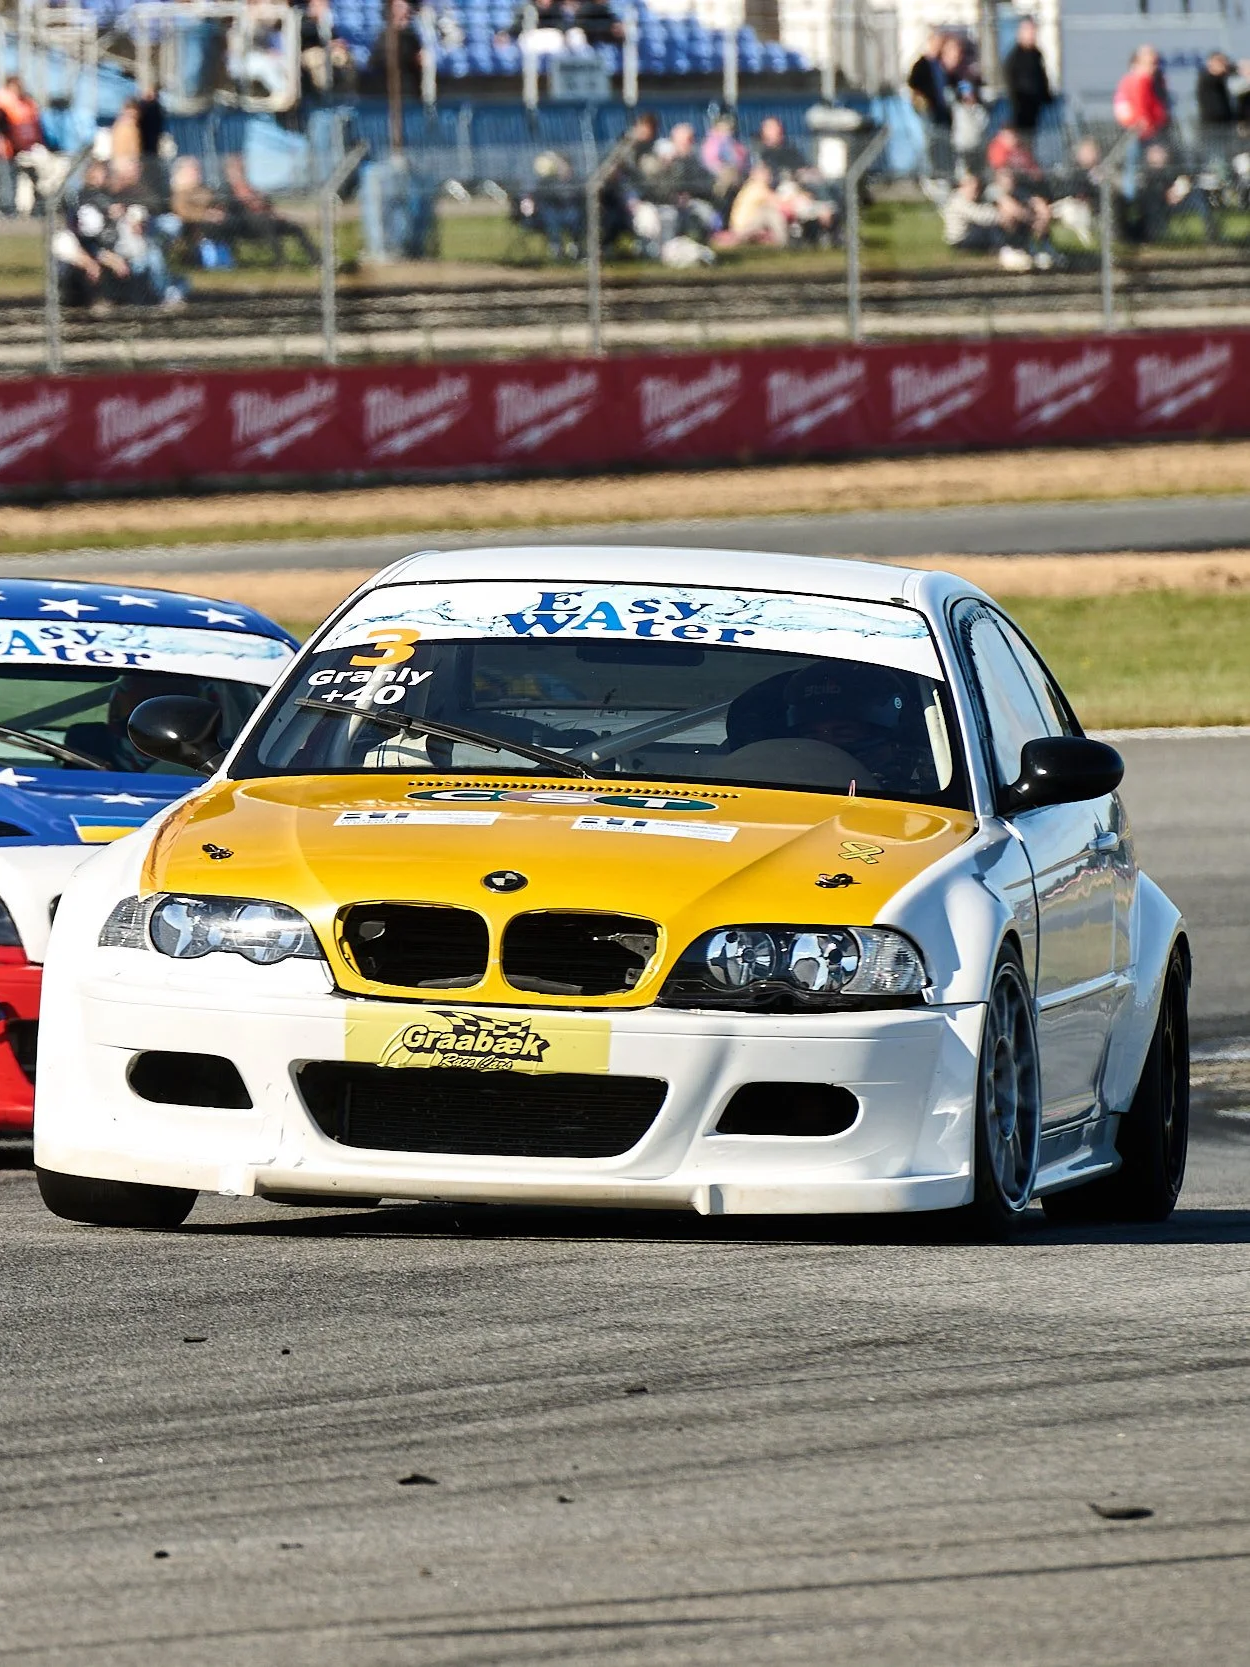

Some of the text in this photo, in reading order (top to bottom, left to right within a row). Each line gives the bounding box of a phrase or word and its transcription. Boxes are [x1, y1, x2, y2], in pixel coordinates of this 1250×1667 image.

[349, 628, 422, 667] 3
[307, 667, 434, 686] Granly
[320, 684, 407, 707] +40
[431, 790, 694, 809] CST
[403, 1025, 550, 1057] Graabæk
[439, 1052, 485, 1069] Race
